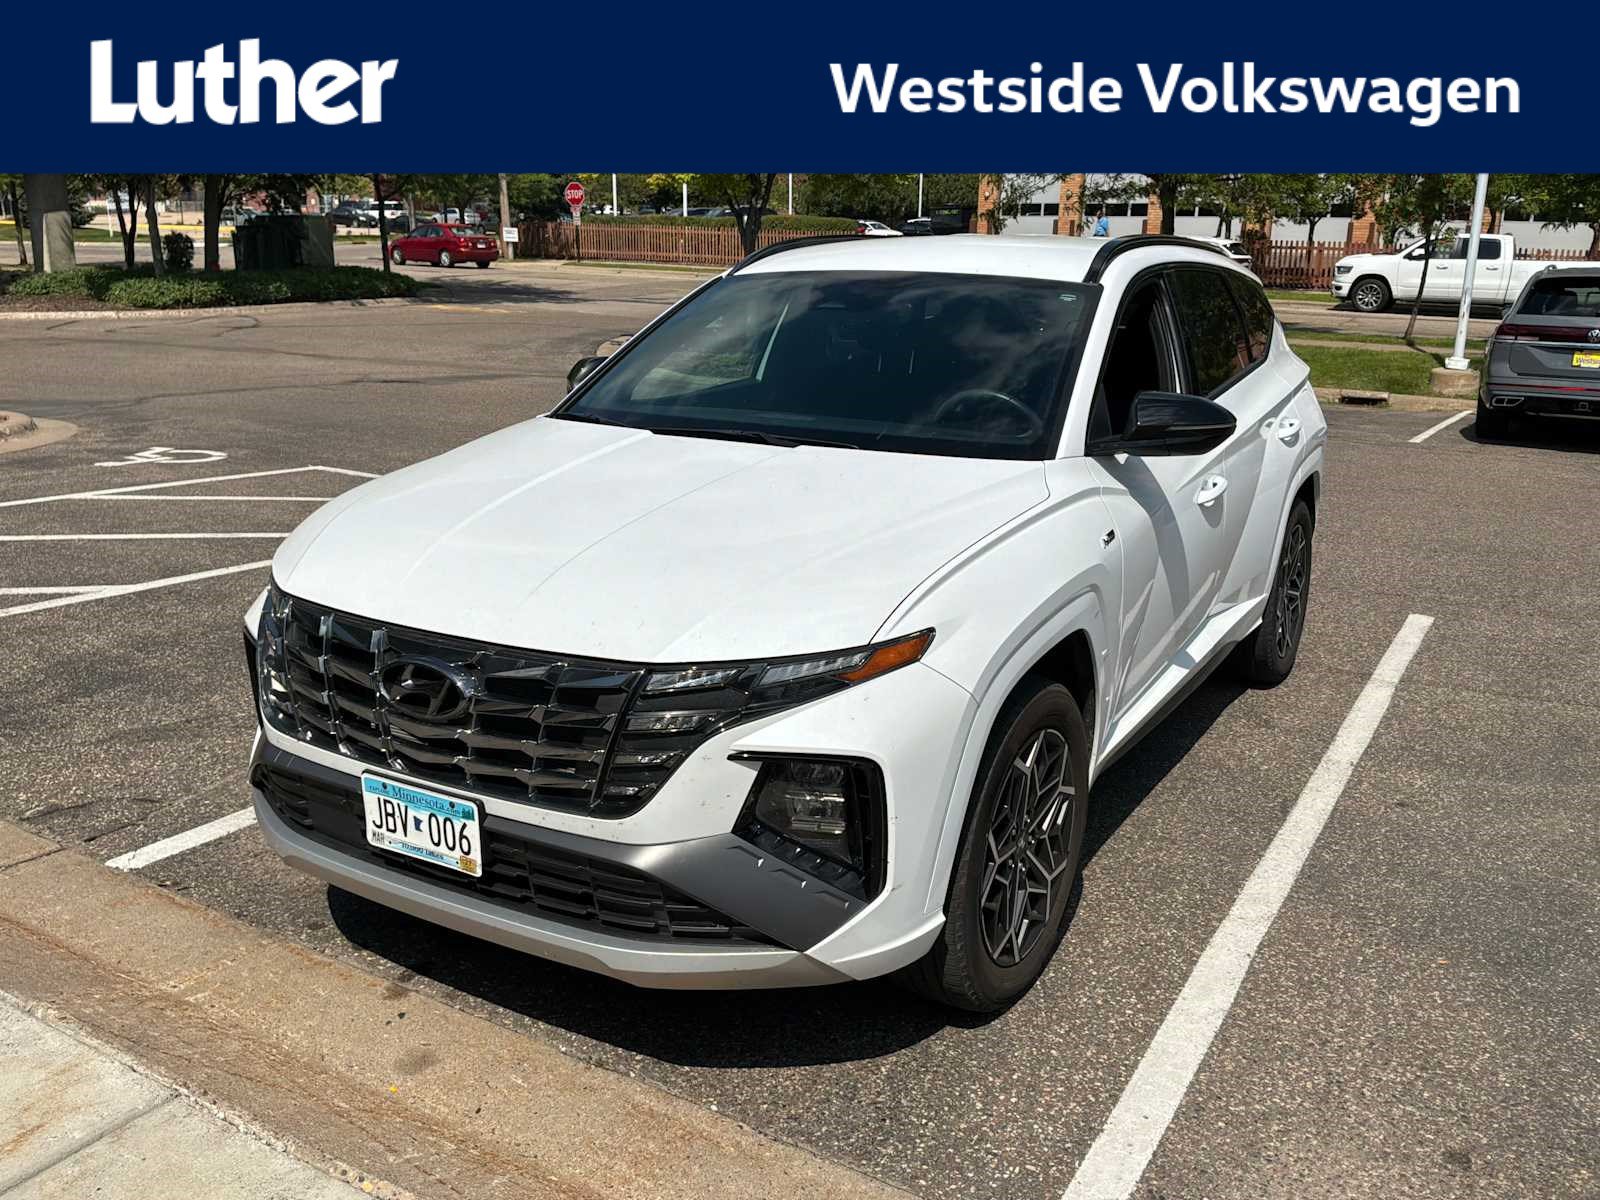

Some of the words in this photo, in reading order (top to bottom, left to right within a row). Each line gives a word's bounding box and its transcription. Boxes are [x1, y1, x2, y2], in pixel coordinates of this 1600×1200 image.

[567, 189, 583, 199] STOP
[372, 796, 408, 838] JBV
[428, 812, 472, 856] 006
